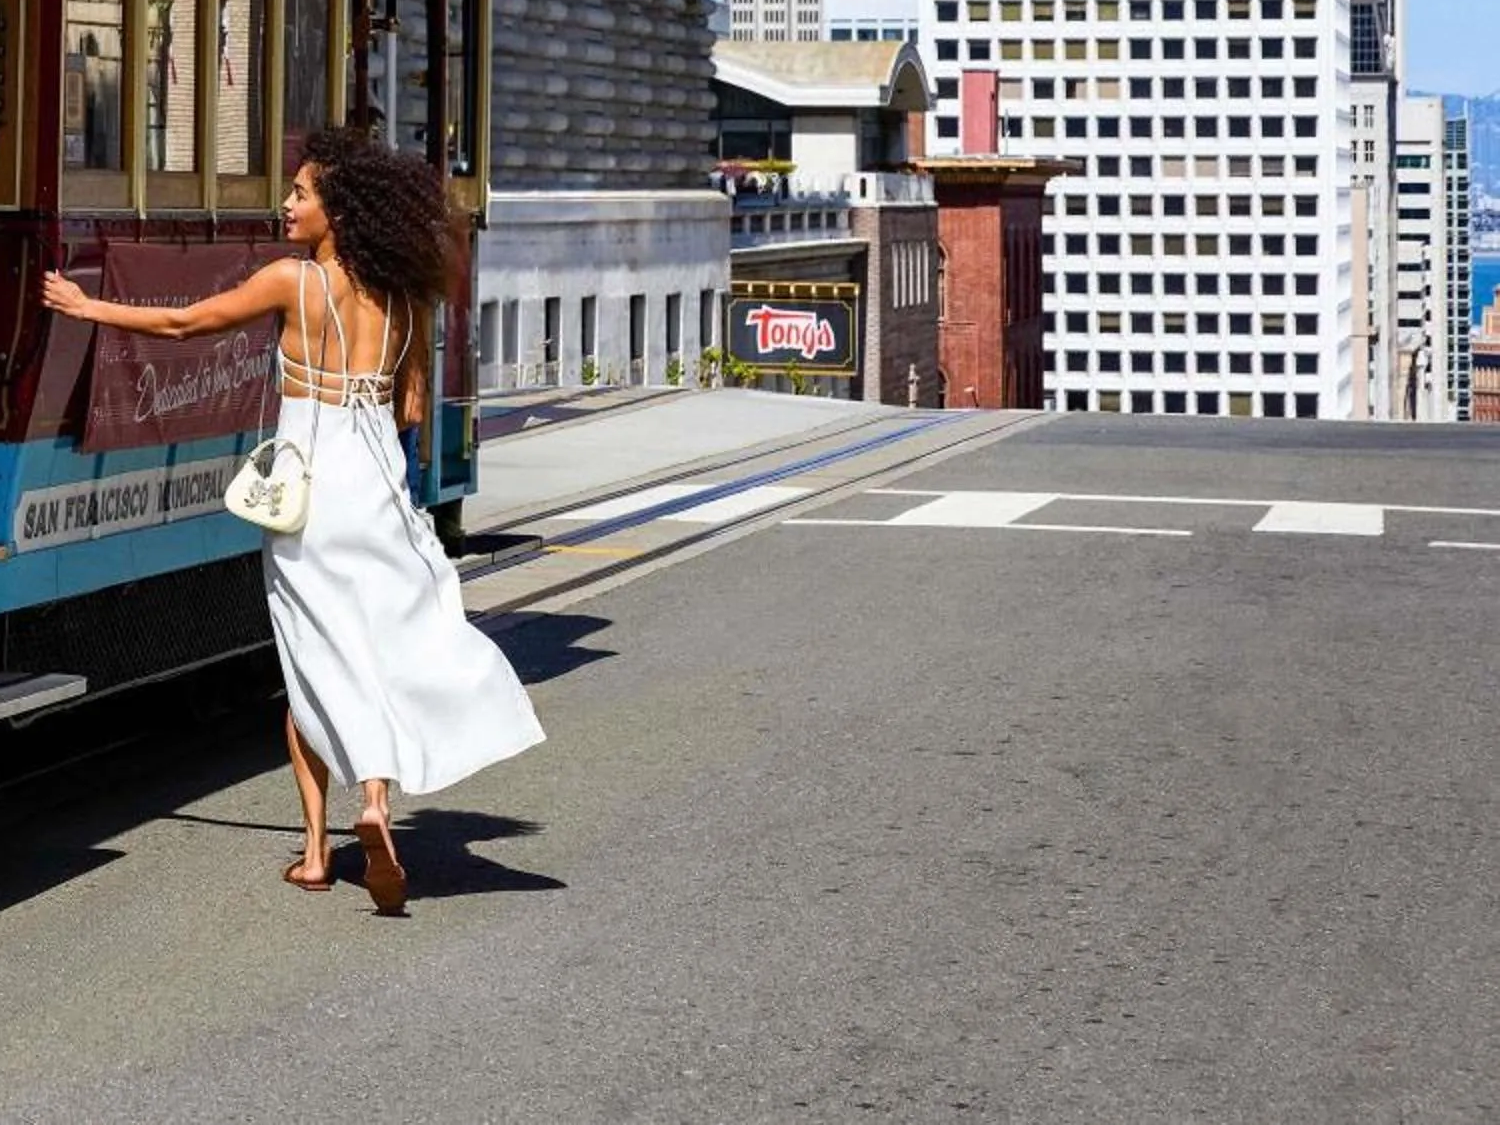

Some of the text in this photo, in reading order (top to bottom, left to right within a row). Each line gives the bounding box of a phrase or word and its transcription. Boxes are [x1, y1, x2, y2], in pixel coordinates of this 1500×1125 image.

[746, 304, 836, 360] Tonga
[23, 467, 226, 540] SAN FRANCISCO MUNICIPAL
